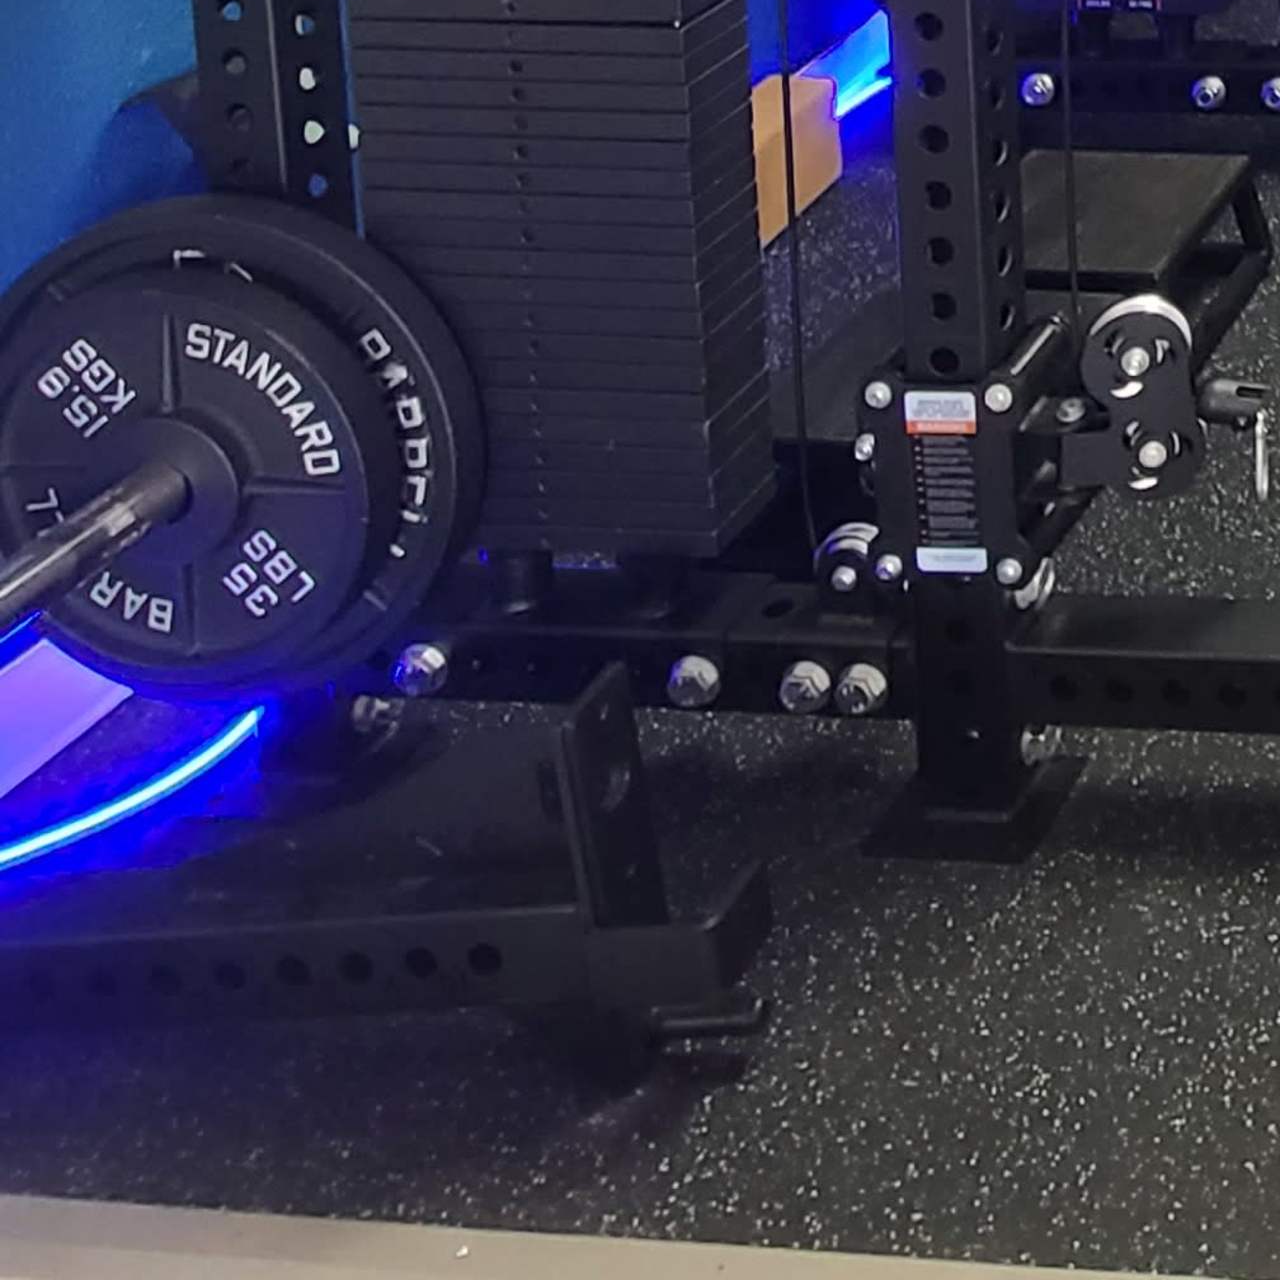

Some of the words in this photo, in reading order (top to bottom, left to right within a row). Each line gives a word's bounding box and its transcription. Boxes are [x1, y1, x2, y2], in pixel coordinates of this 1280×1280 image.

[62, 338, 137, 415] KGS
[184, 322, 341, 477] STANDARD
[222, 562, 280, 618] 35
[242, 529, 316, 603] LBS
